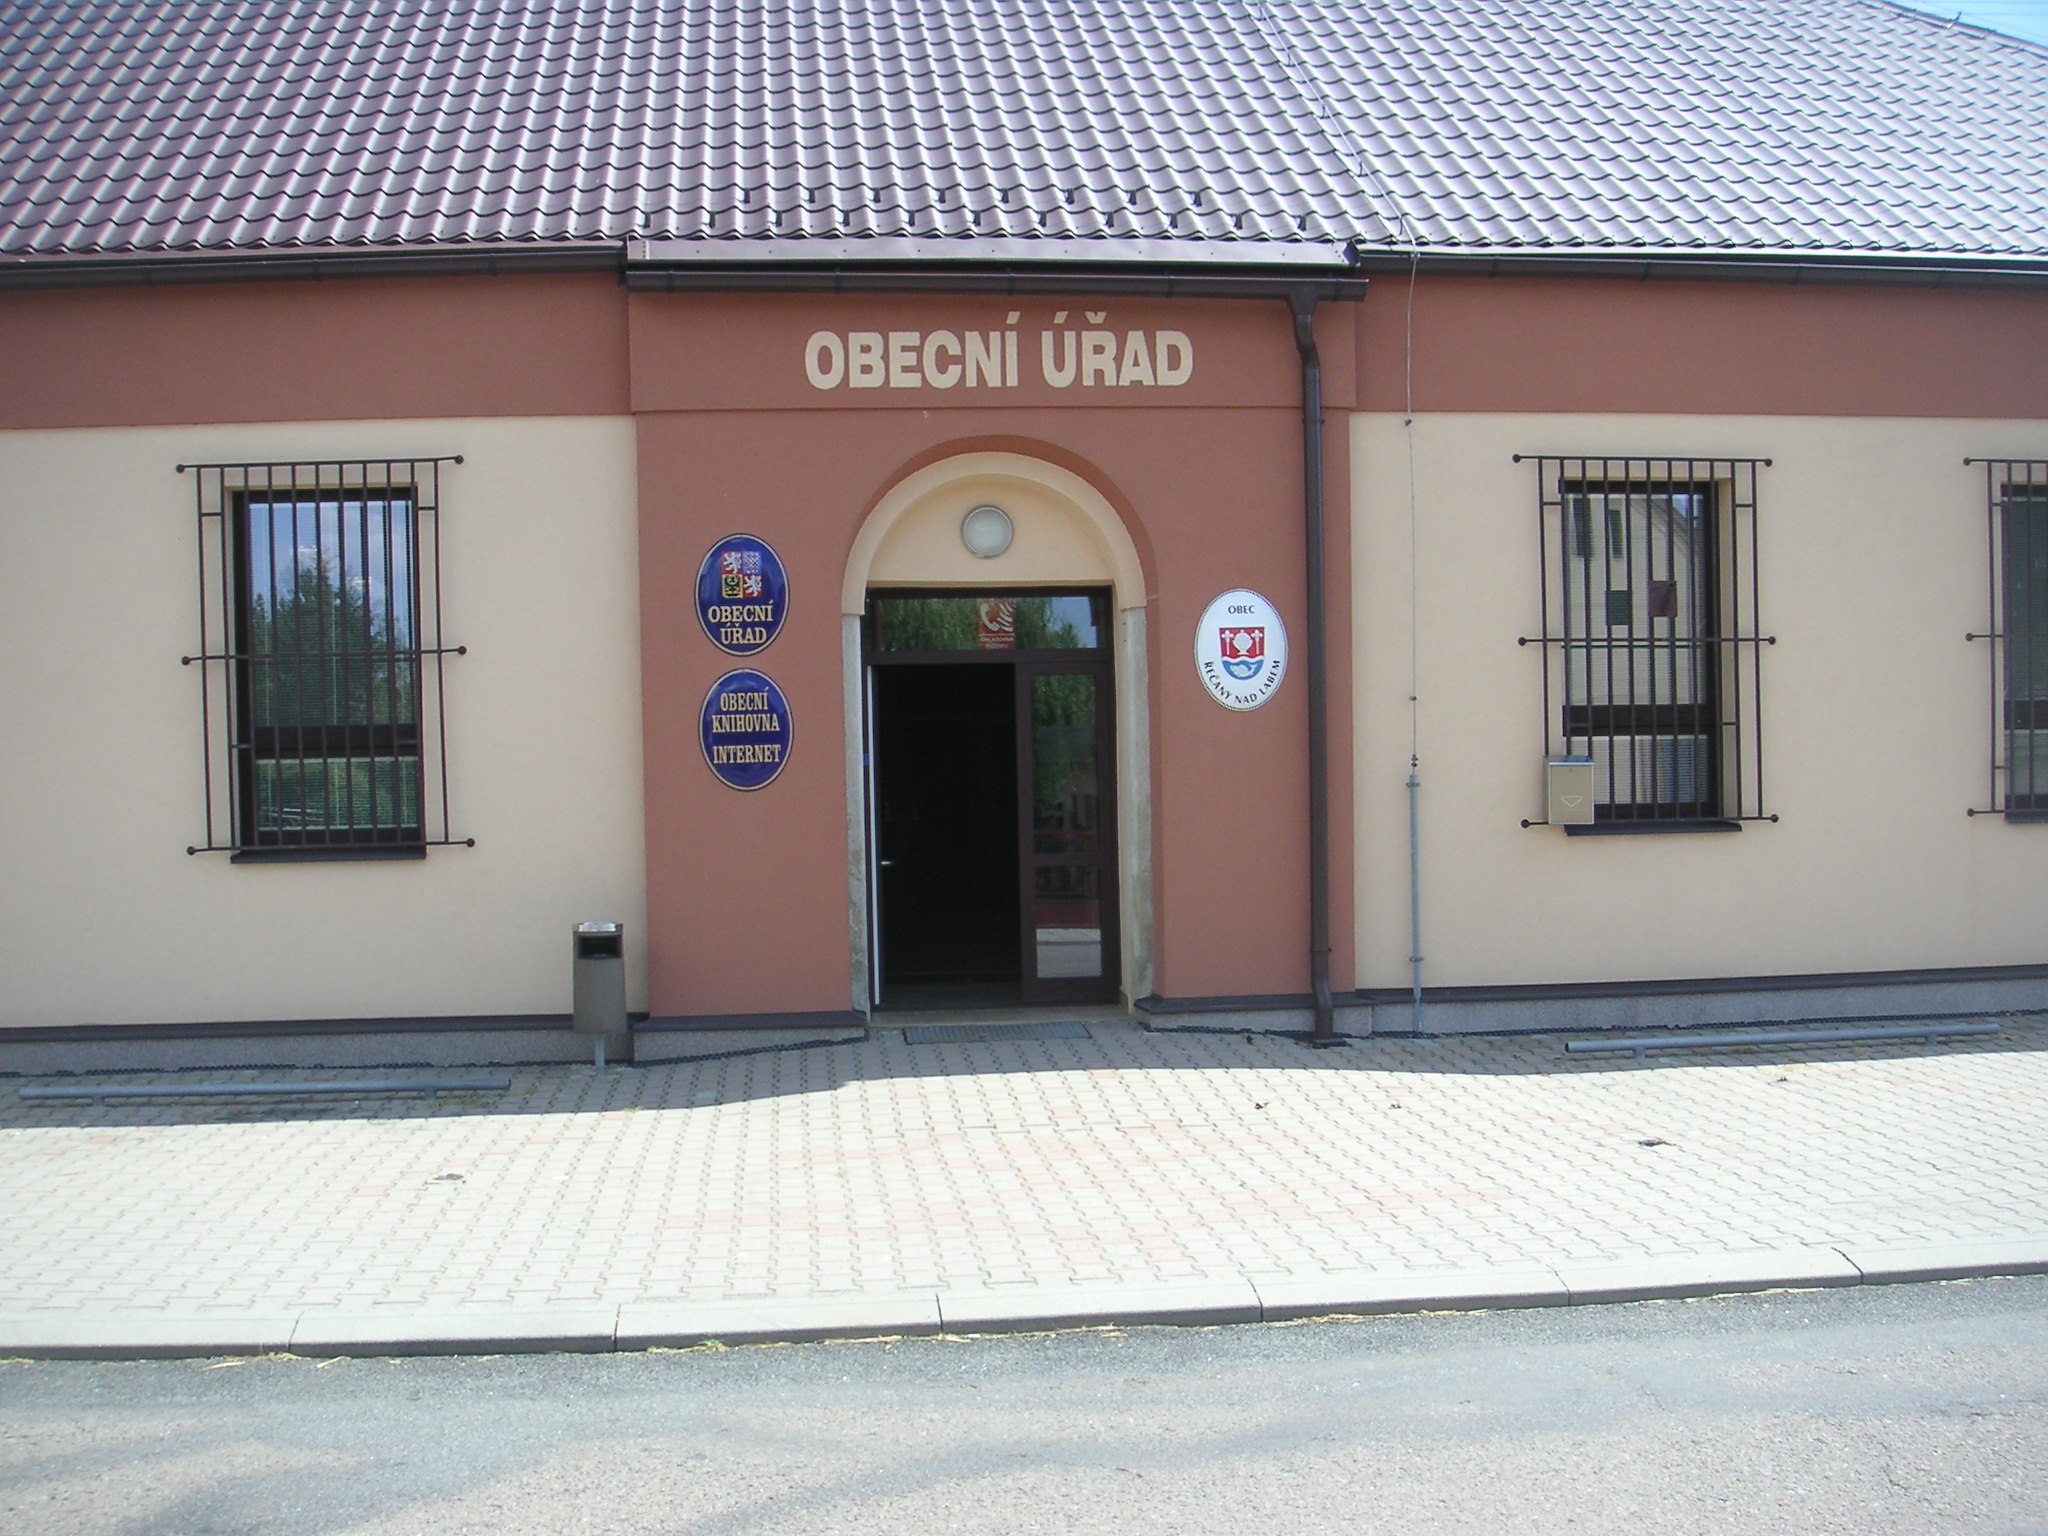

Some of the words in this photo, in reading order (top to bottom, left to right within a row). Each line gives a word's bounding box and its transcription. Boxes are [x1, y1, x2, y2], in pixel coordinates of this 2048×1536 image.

[804, 311, 1020, 390] OBECNÍ
[1041, 311, 1193, 389] ÚŘAD
[707, 599, 774, 623] OBECNÍ
[1228, 605, 1255, 614] OBEC
[720, 622, 767, 644] ÚŘAD
[1234, 693, 1257, 704] NAD
[1259, 660, 1280, 695] LABEM
[720, 686, 769, 712] OBECNÍ
[712, 713, 780, 733] KNIHOVNA
[713, 744, 781, 764] INTERNET
